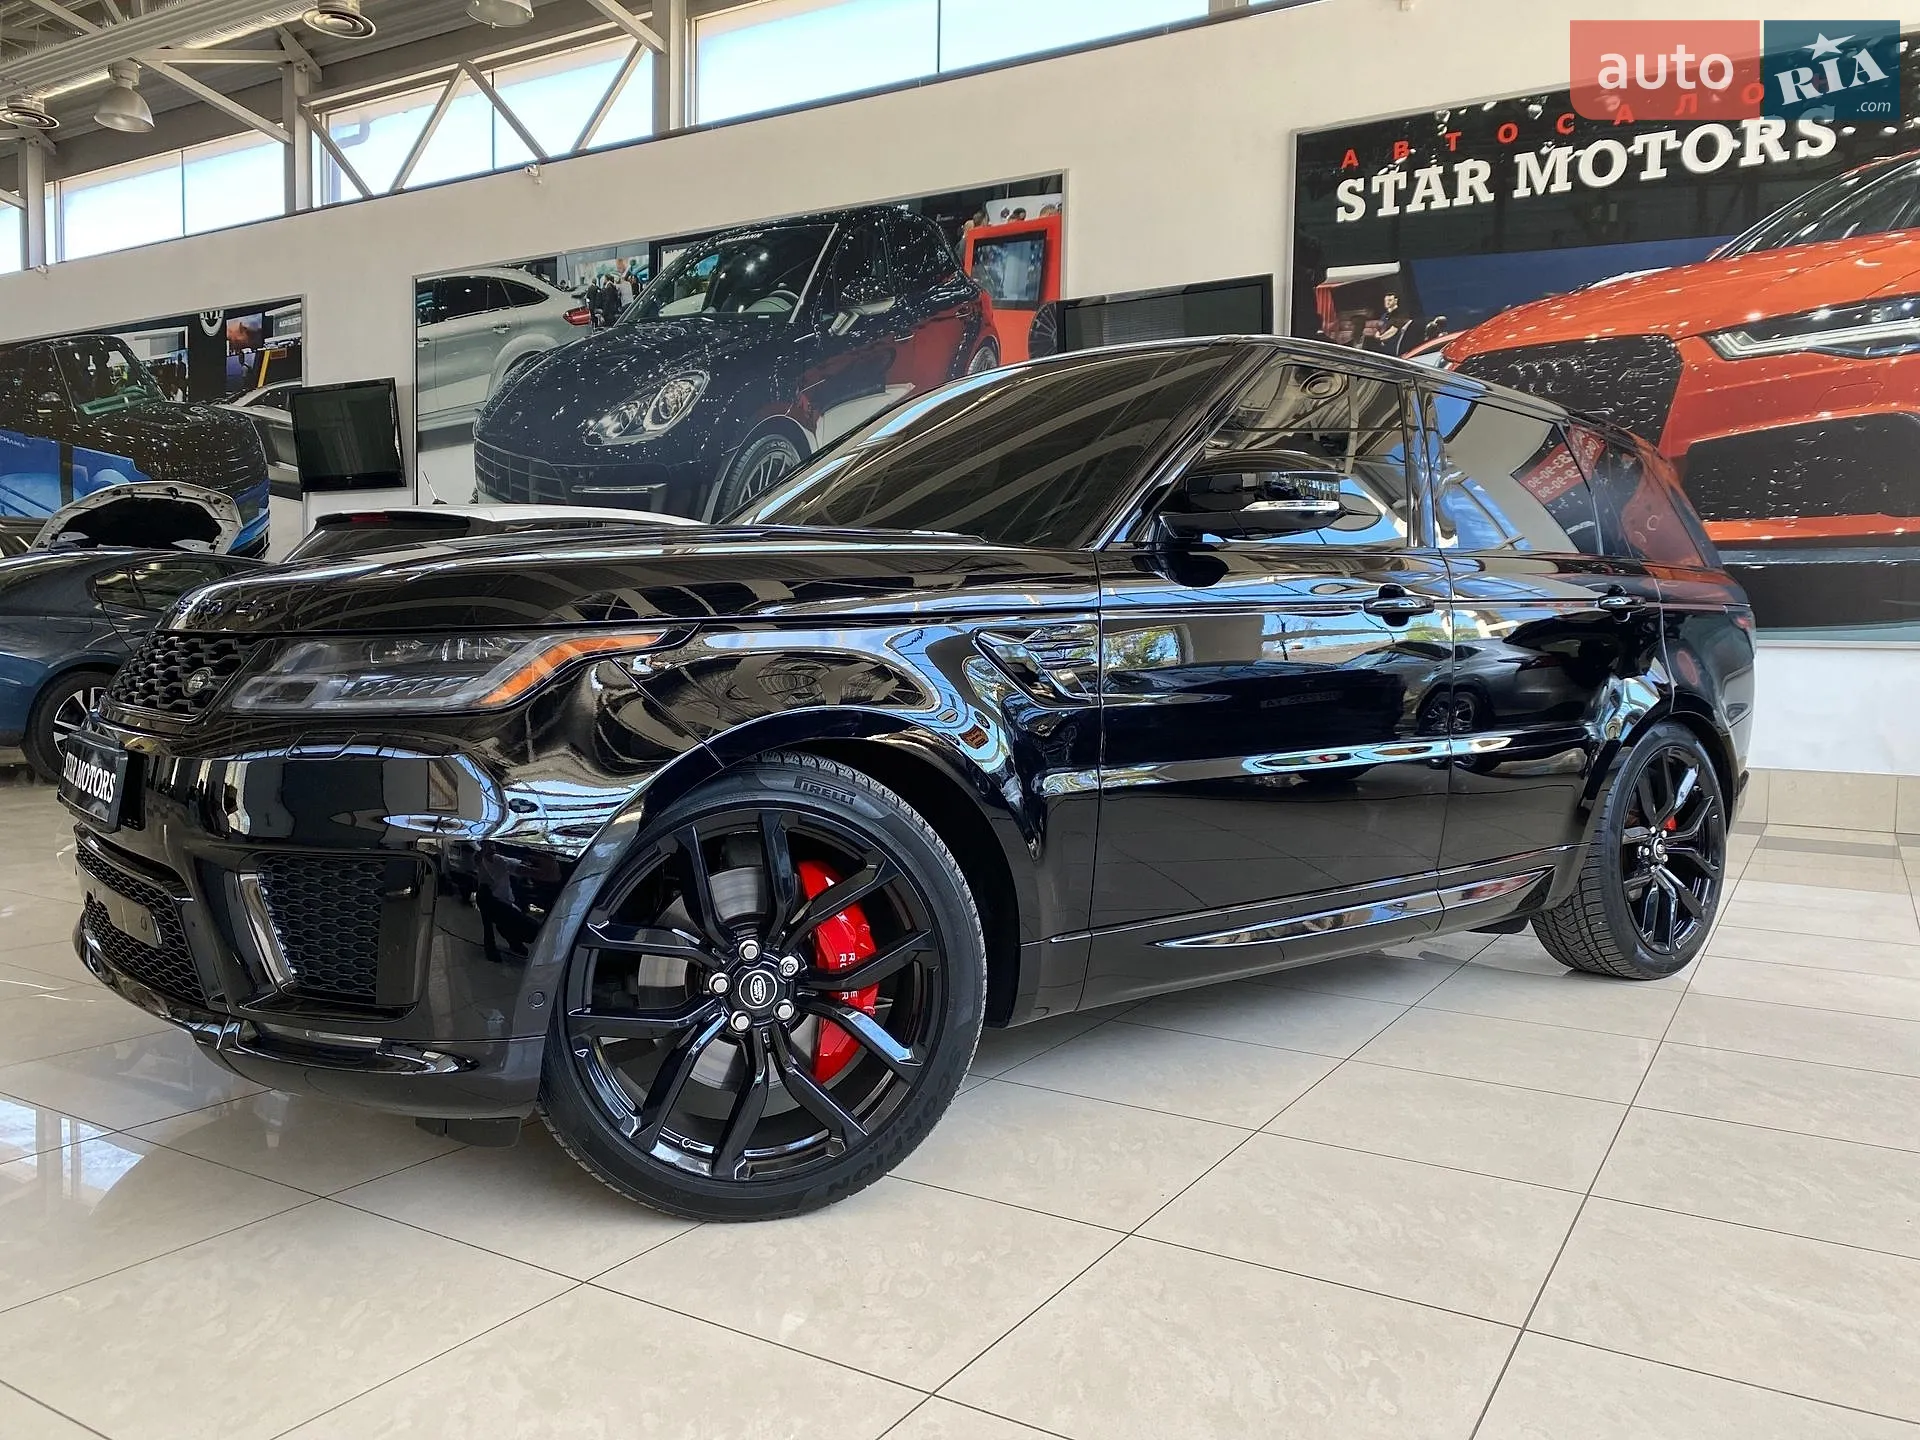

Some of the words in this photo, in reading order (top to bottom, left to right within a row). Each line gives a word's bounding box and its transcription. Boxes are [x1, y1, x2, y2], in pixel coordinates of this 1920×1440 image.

[1336, 158, 1495, 223] STAR
[1512, 105, 1837, 199] MOTORS
[74, 759, 117, 804] MOTORS
[793, 775, 856, 805] PIRELLI
